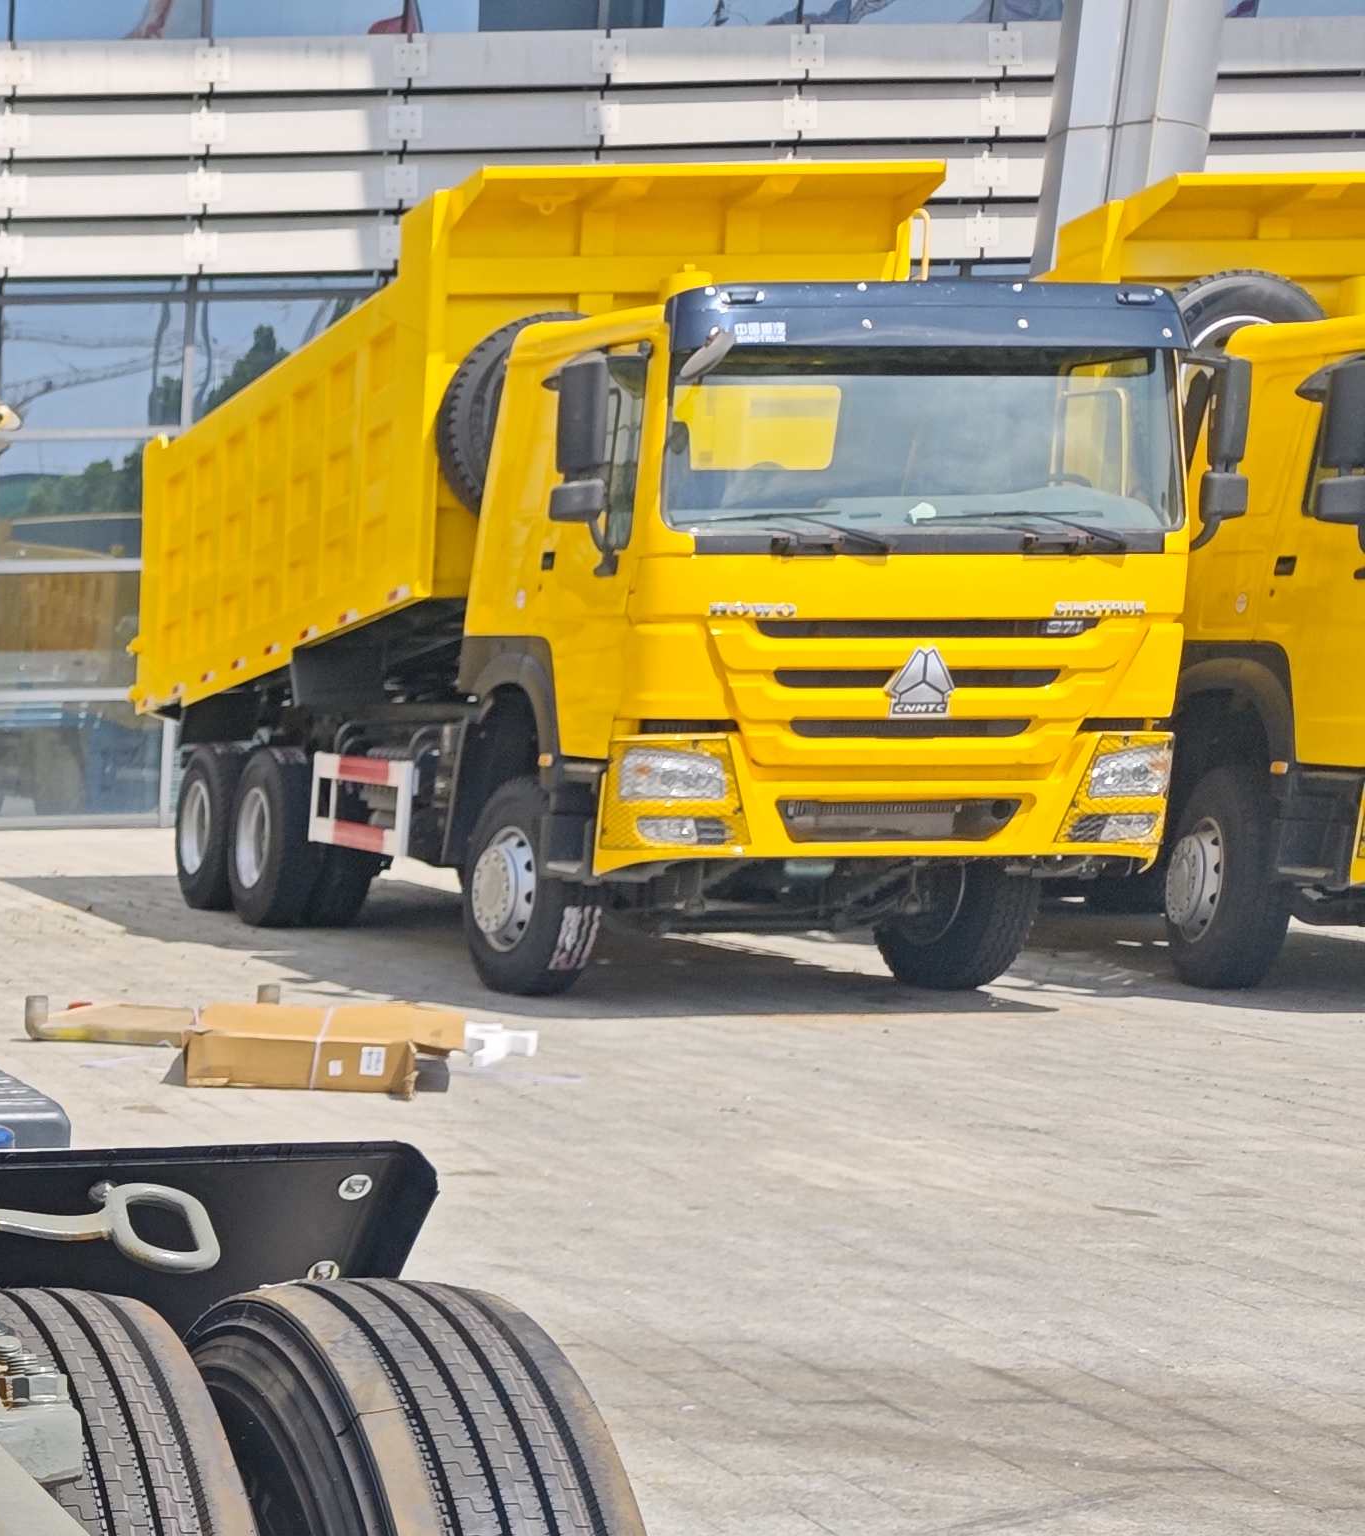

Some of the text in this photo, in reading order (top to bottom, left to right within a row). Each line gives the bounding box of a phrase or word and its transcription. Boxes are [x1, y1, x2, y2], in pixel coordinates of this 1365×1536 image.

[709, 602, 797, 617] HOWO
[1054, 602, 1146, 616] SINOTRUK
[894, 703, 946, 713] CNHTC
